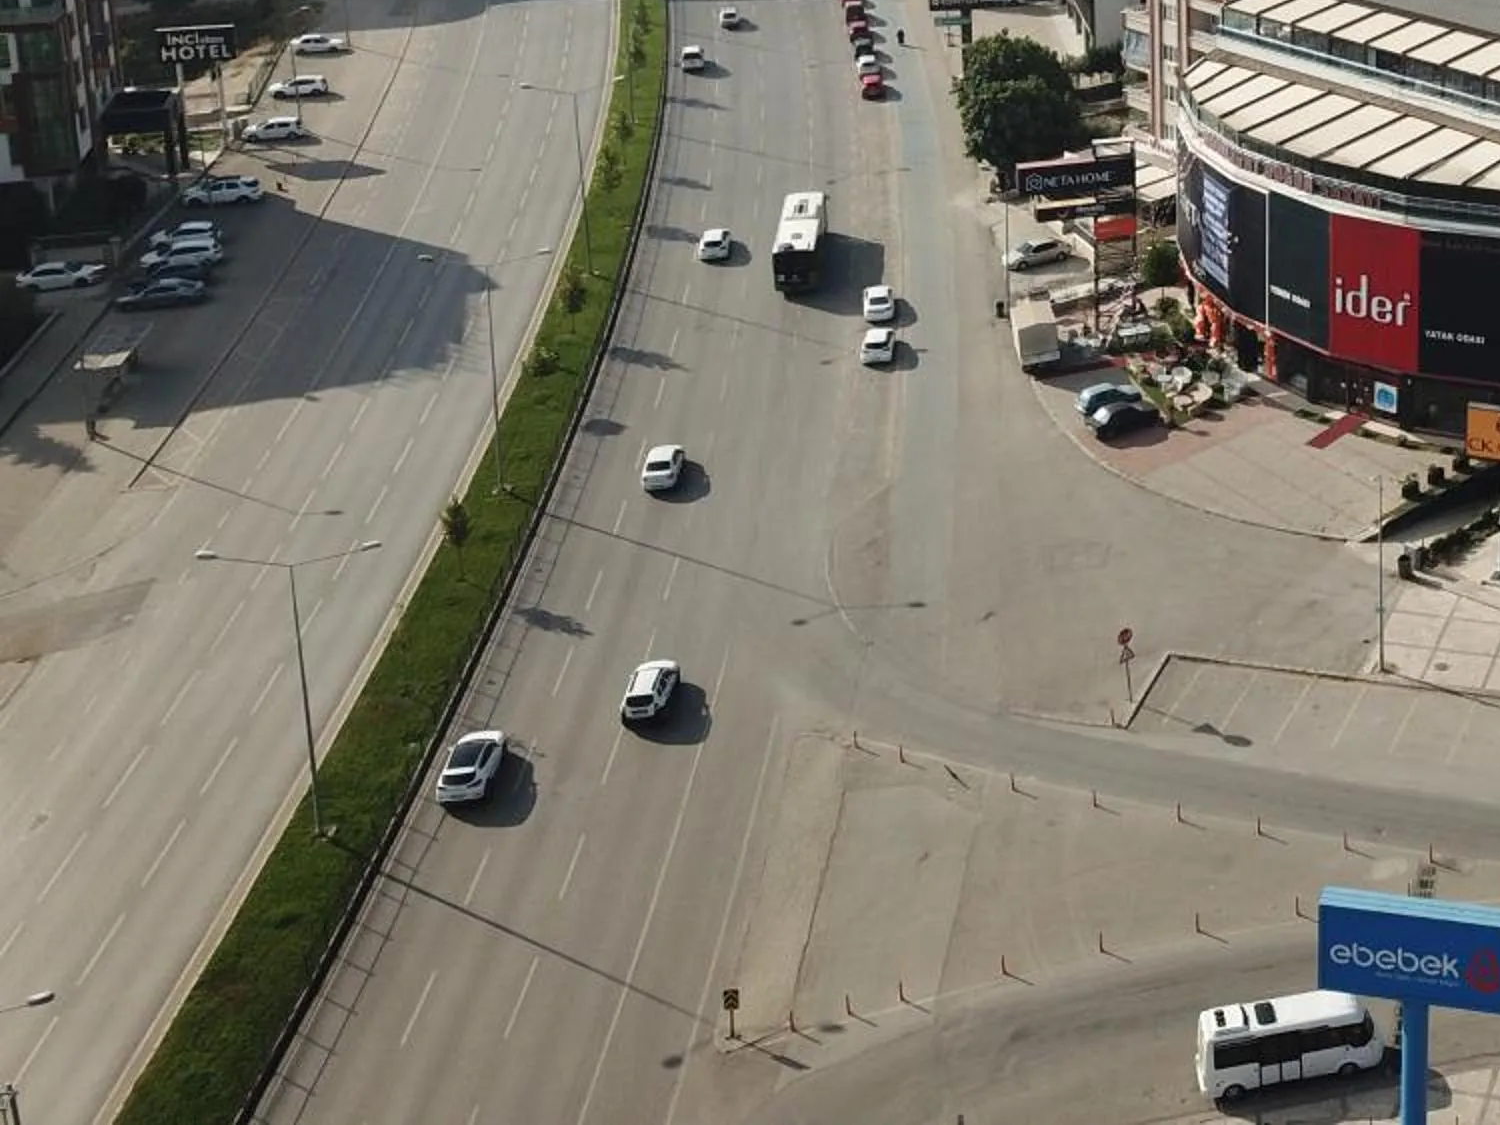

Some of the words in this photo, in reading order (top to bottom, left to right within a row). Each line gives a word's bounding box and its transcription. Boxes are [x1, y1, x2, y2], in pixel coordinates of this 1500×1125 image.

[161, 44, 231, 62] HOTEL
[1076, 170, 1112, 185] HOME
[1468, 437, 1494, 453] CK
[1329, 942, 1460, 979] ebebek
